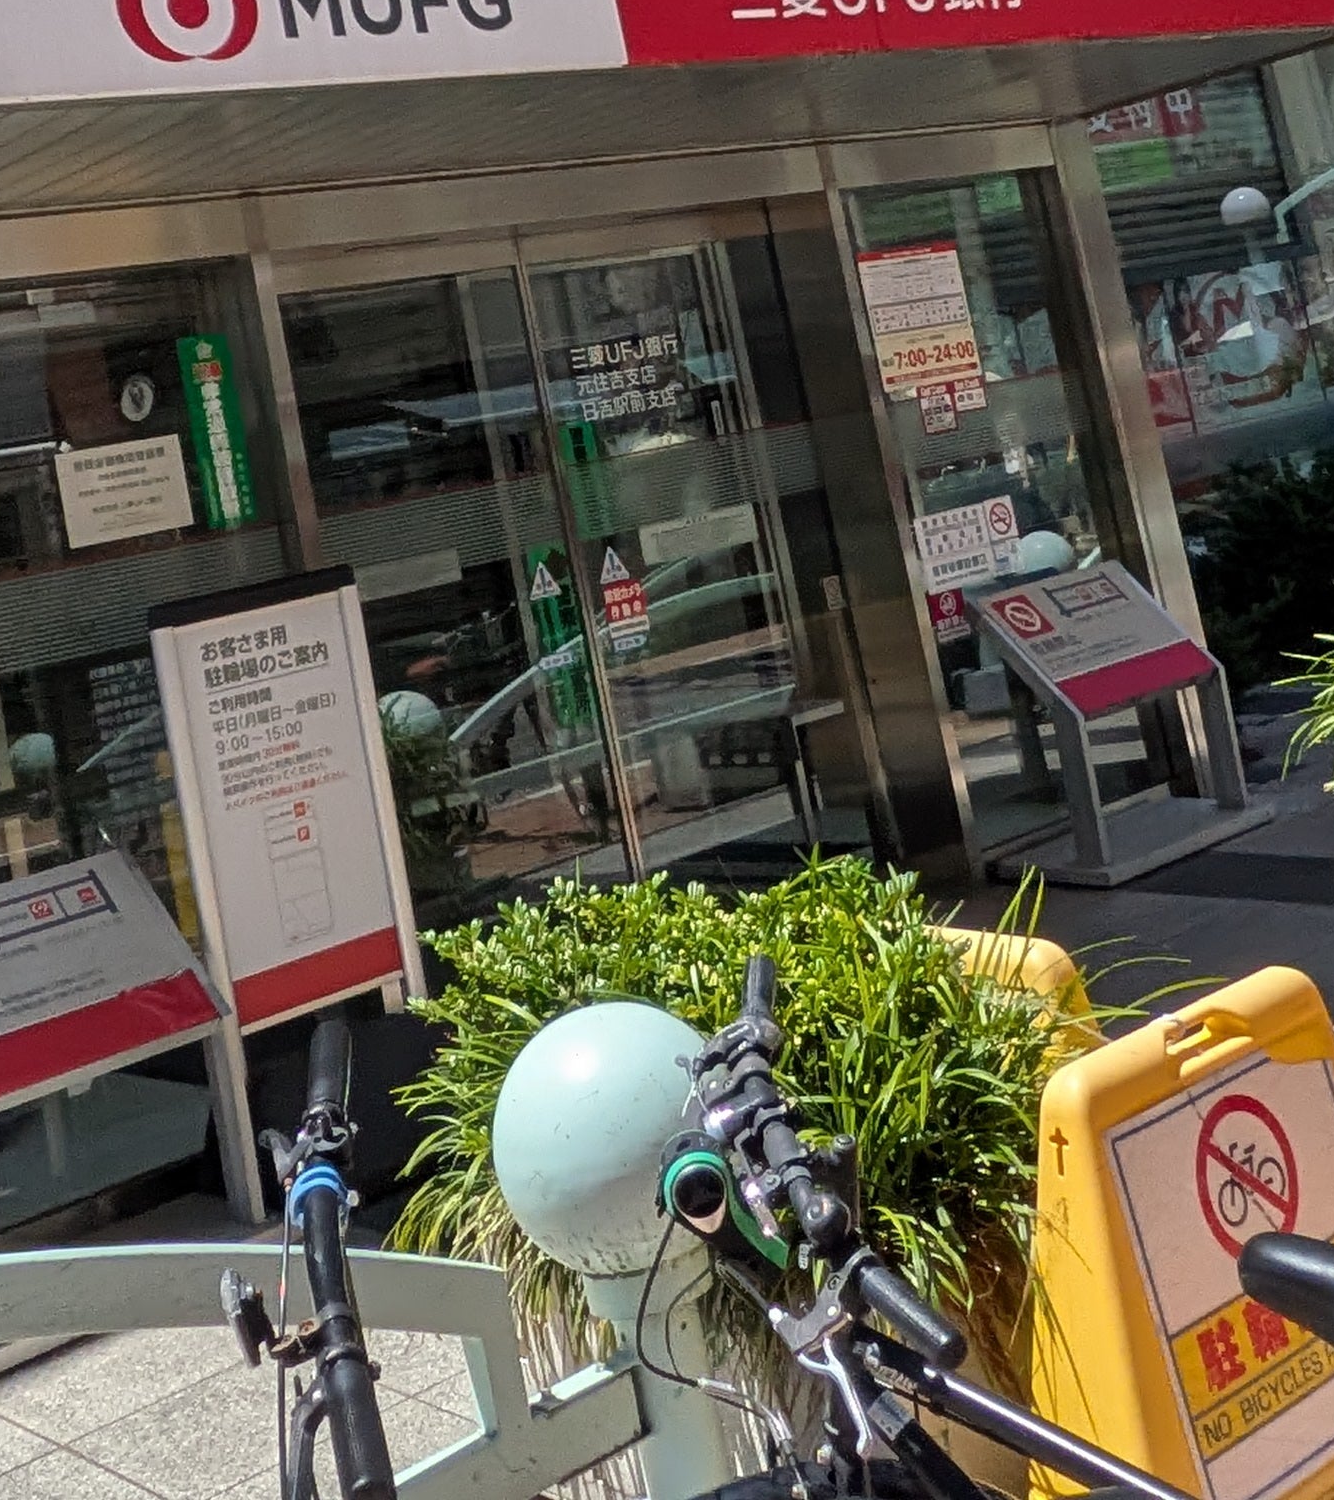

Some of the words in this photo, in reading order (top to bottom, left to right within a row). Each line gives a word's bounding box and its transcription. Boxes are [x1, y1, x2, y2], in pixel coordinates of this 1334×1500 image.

[570, 333, 679, 371] 三菱UFJ銀行
[576, 365, 657, 397] 元住吉支店
[581, 386, 678, 422] 日吉駅前支店
[200, 624, 287, 663] お客さま用
[204, 640, 329, 689] 駐輪場のご案内
[209, 687, 273, 716] ご利用時間
[1195, 1300, 1295, 1392] 駐輪
[1202, 1409, 1233, 1448] NO
[1238, 1356, 1325, 1424] BICYCLES
